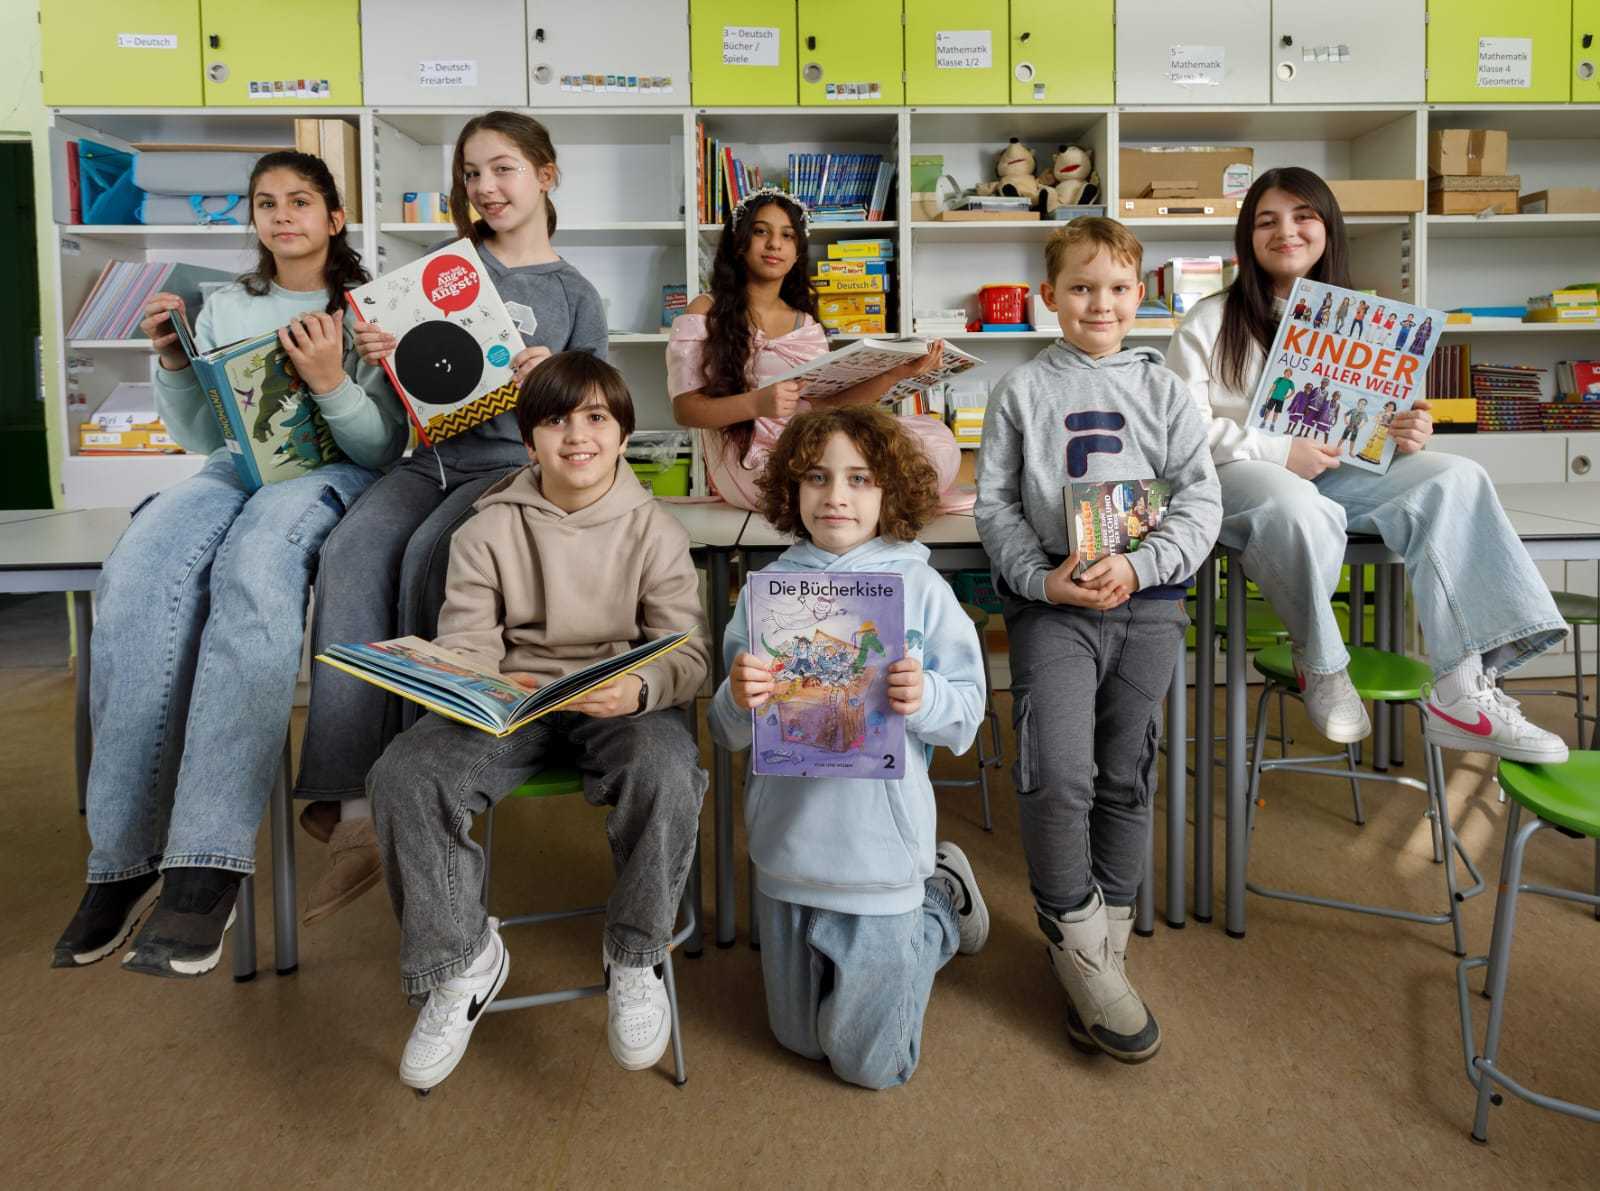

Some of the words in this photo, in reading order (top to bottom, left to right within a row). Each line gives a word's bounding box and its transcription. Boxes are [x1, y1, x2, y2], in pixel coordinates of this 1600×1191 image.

[722, 29, 729, 37] 3
[738, 29, 773, 38] Deutsch
[936, 32, 942, 41] 4
[134, 36, 170, 46] Deutsch
[723, 40, 754, 50] Bücher
[936, 45, 987, 54] Mathematik
[1170, 47, 1177, 57] 5
[722, 54, 750, 64] Spiele
[1479, 51, 1528, 61] Mathematik
[937, 58, 963, 66] Klasse
[965, 58, 980, 66] 1/2
[1170, 59, 1222, 69] Mathematik
[419, 63, 425, 72] 2
[435, 63, 471, 72] Deutsch
[1478, 64, 1504, 73] Klasse
[1505, 64, 1512, 73] 4
[419, 76, 463, 85] Freiarbeit
[432, 272, 478, 302] Angst?
[837, 281, 869, 290] Deutsch
[1283, 325, 1419, 386] KINDER
[1278, 351, 1311, 372] AUS
[1312, 362, 1361, 386] ALLER
[1365, 376, 1413, 400] WELT
[769, 580, 797, 596] Die
[800, 579, 894, 598] Bücherkiste
[882, 753, 896, 770] 2
